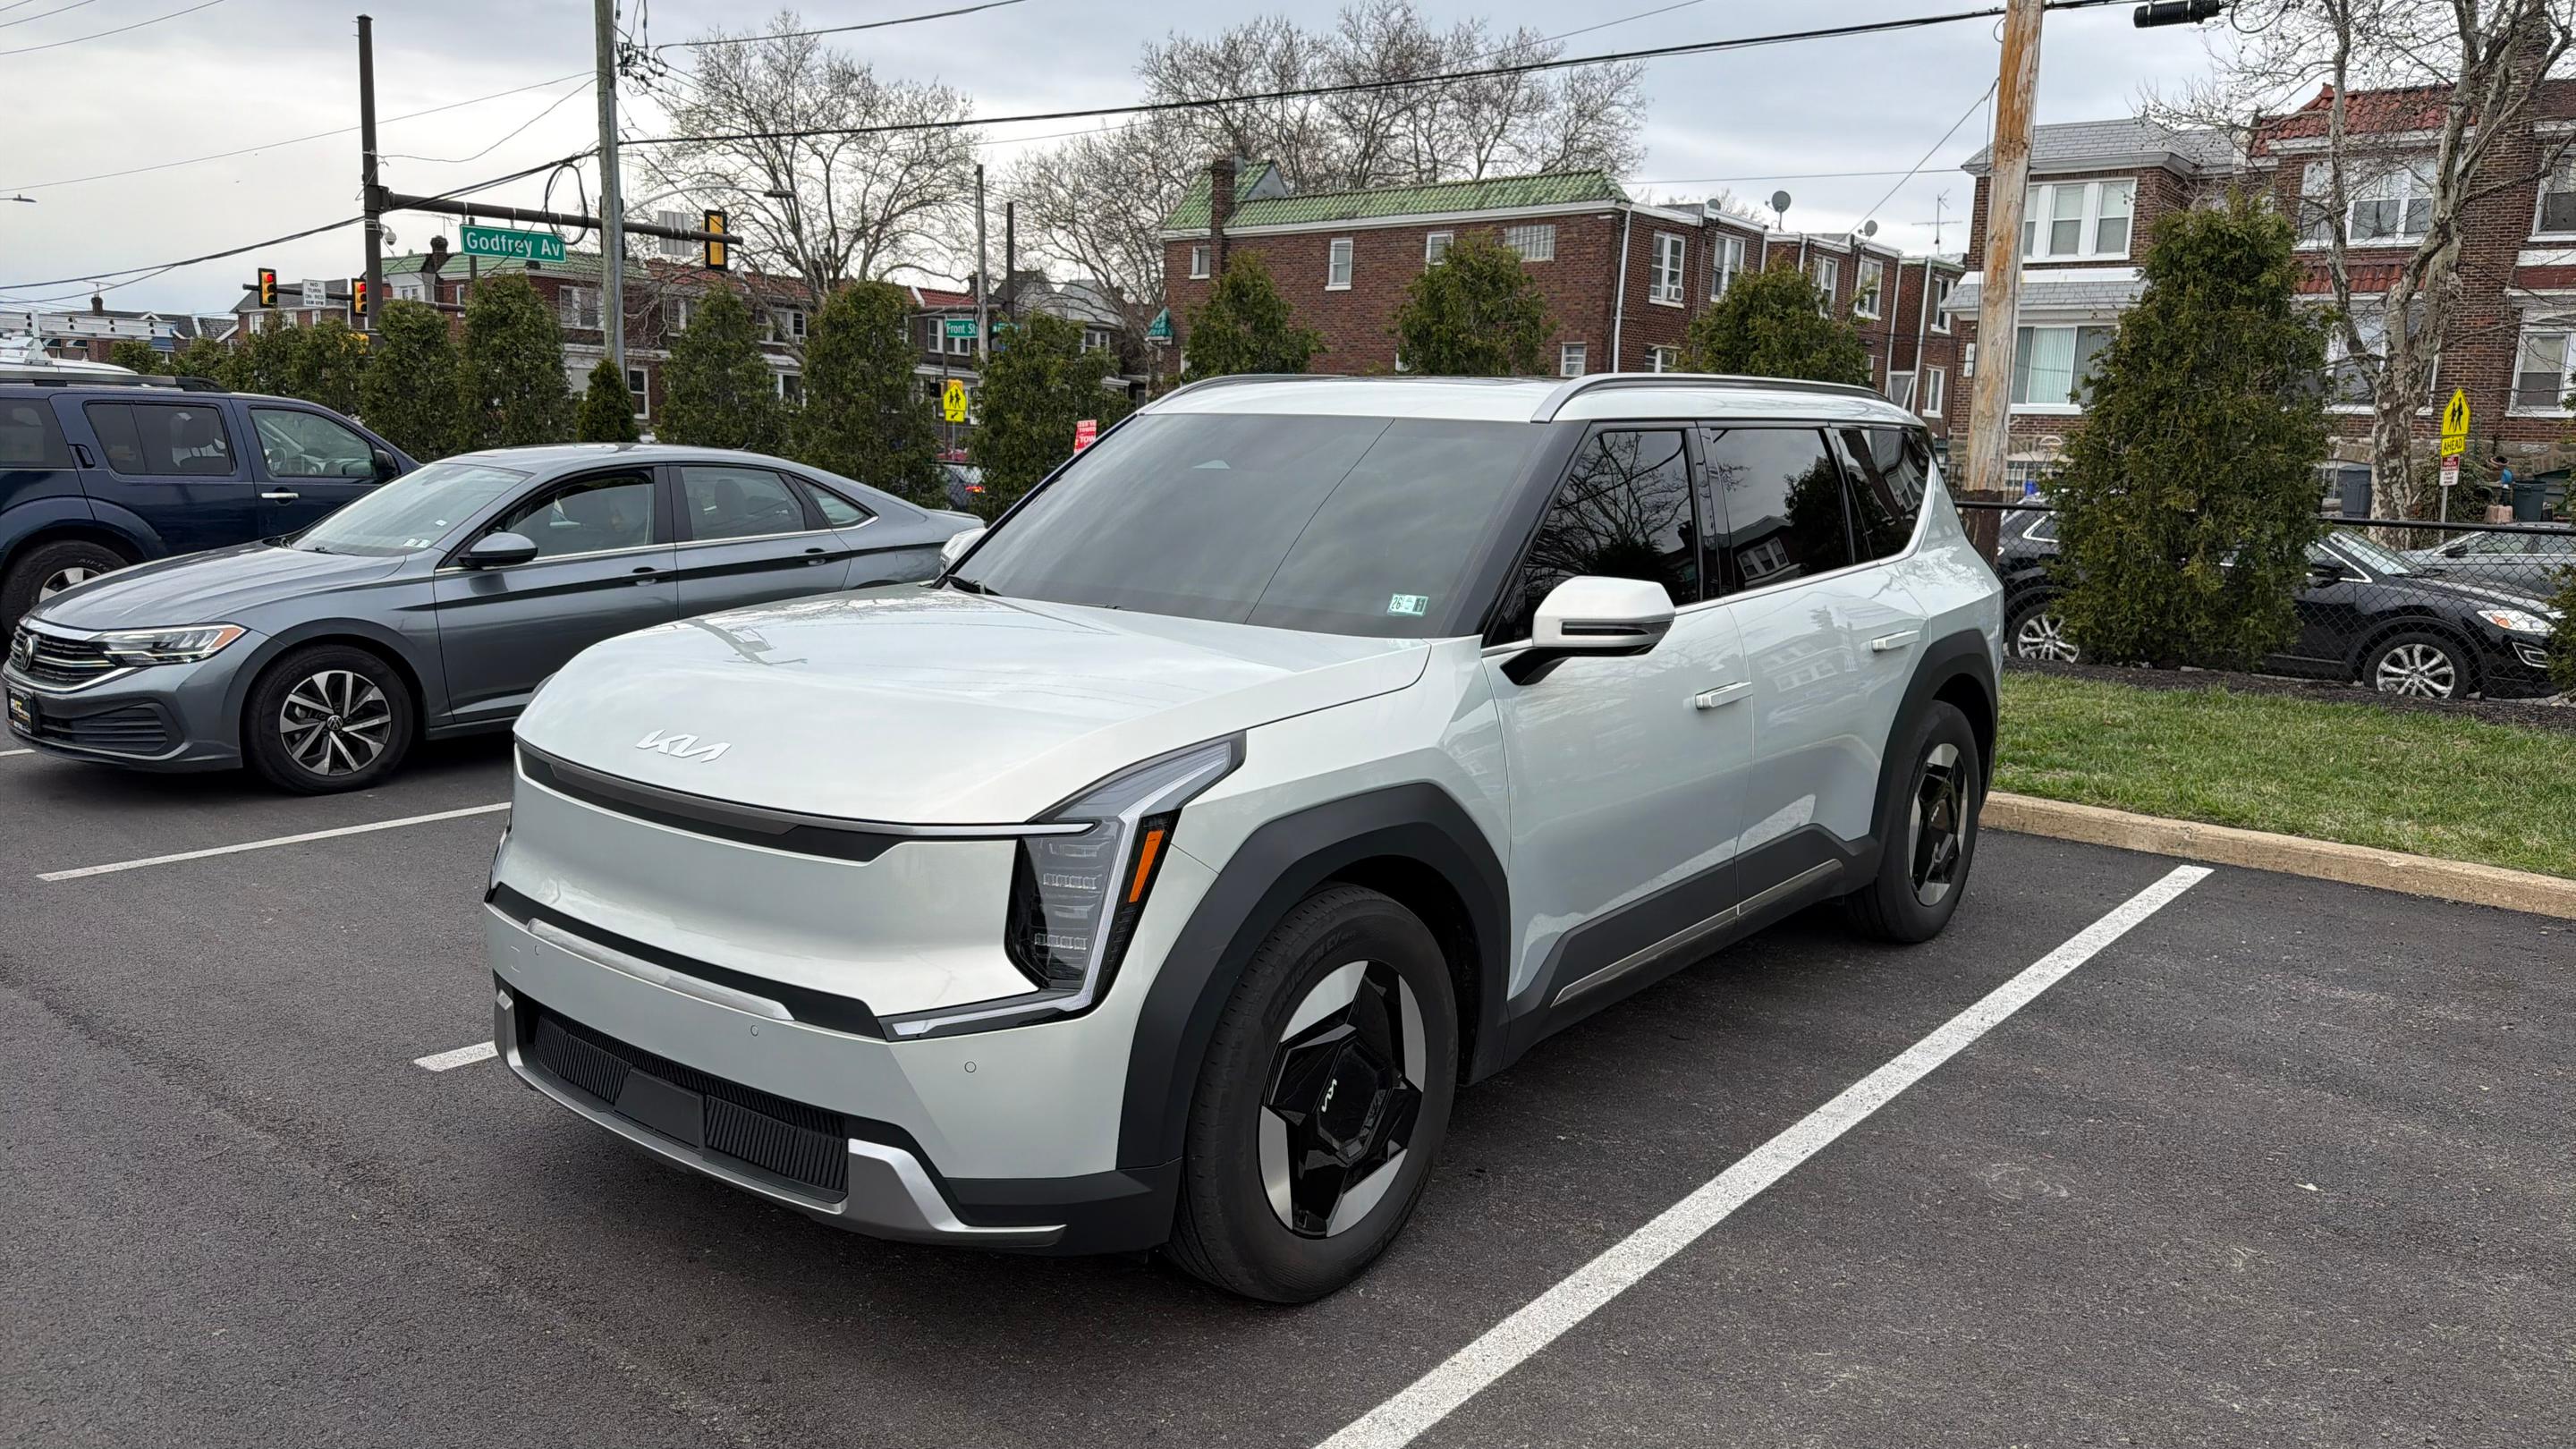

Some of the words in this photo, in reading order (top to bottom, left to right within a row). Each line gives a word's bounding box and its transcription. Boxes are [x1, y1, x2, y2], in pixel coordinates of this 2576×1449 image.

[466, 232, 533, 258] Godfrey
[540, 238, 561, 257] Av
[946, 322, 965, 335] Front
[968, 323, 976, 335] St
[2443, 437, 2462, 453] AHEAD
[1391, 597, 1403, 609] 26
[635, 729, 732, 763] KIA
